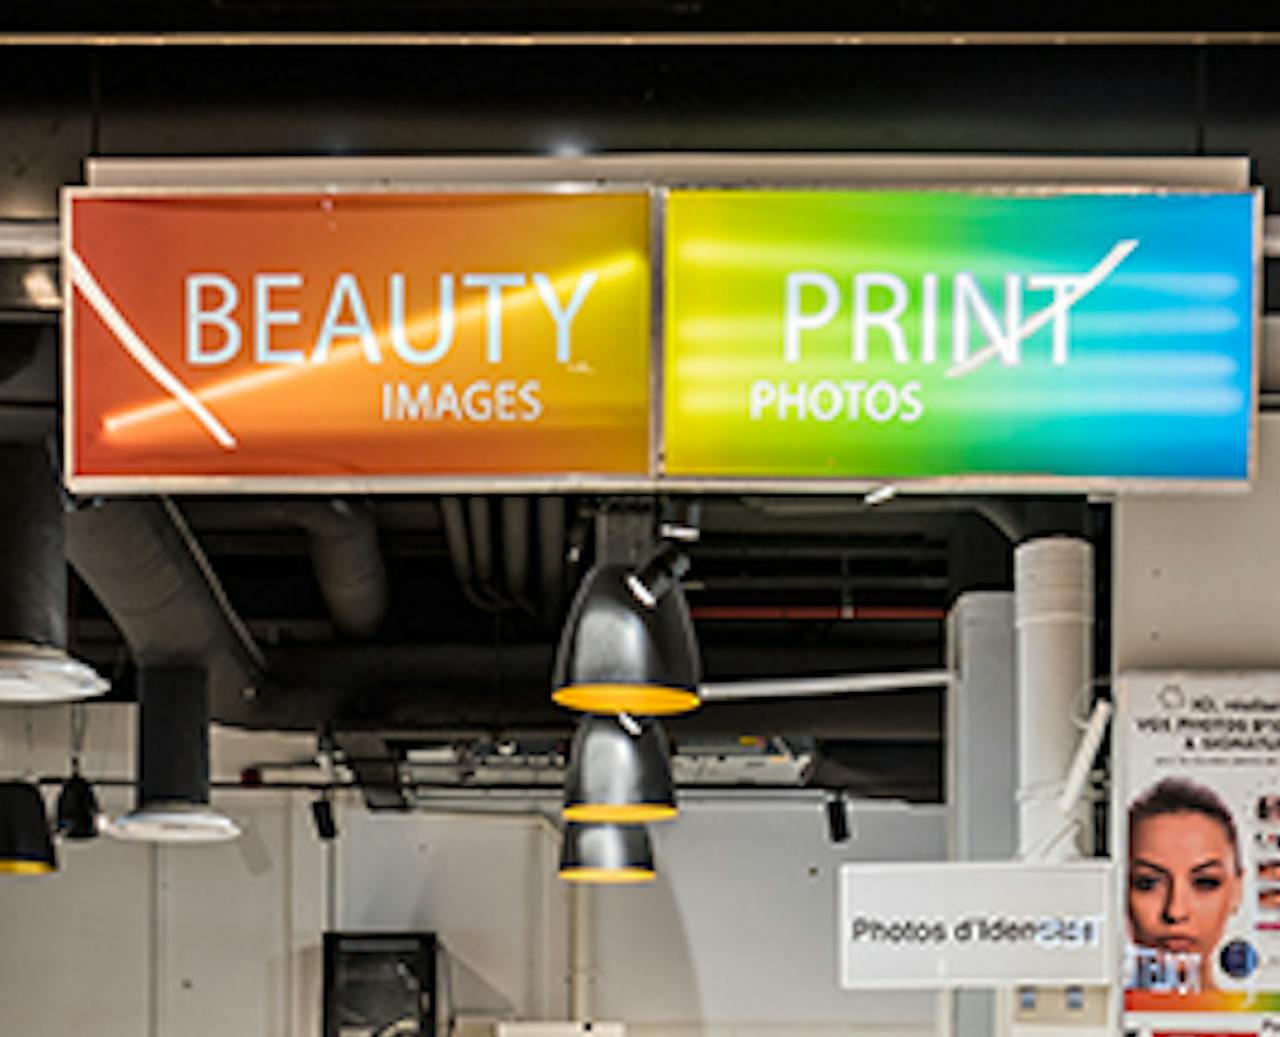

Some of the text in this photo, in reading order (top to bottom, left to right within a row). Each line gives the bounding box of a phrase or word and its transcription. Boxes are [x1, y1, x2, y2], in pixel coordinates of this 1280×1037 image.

[185, 272, 598, 365] BEAUTY
[784, 271, 1090, 366] PRINT
[381, 379, 543, 422] IMAGES
[749, 379, 924, 422] PHOTOS
[851, 917, 947, 943] Photos
